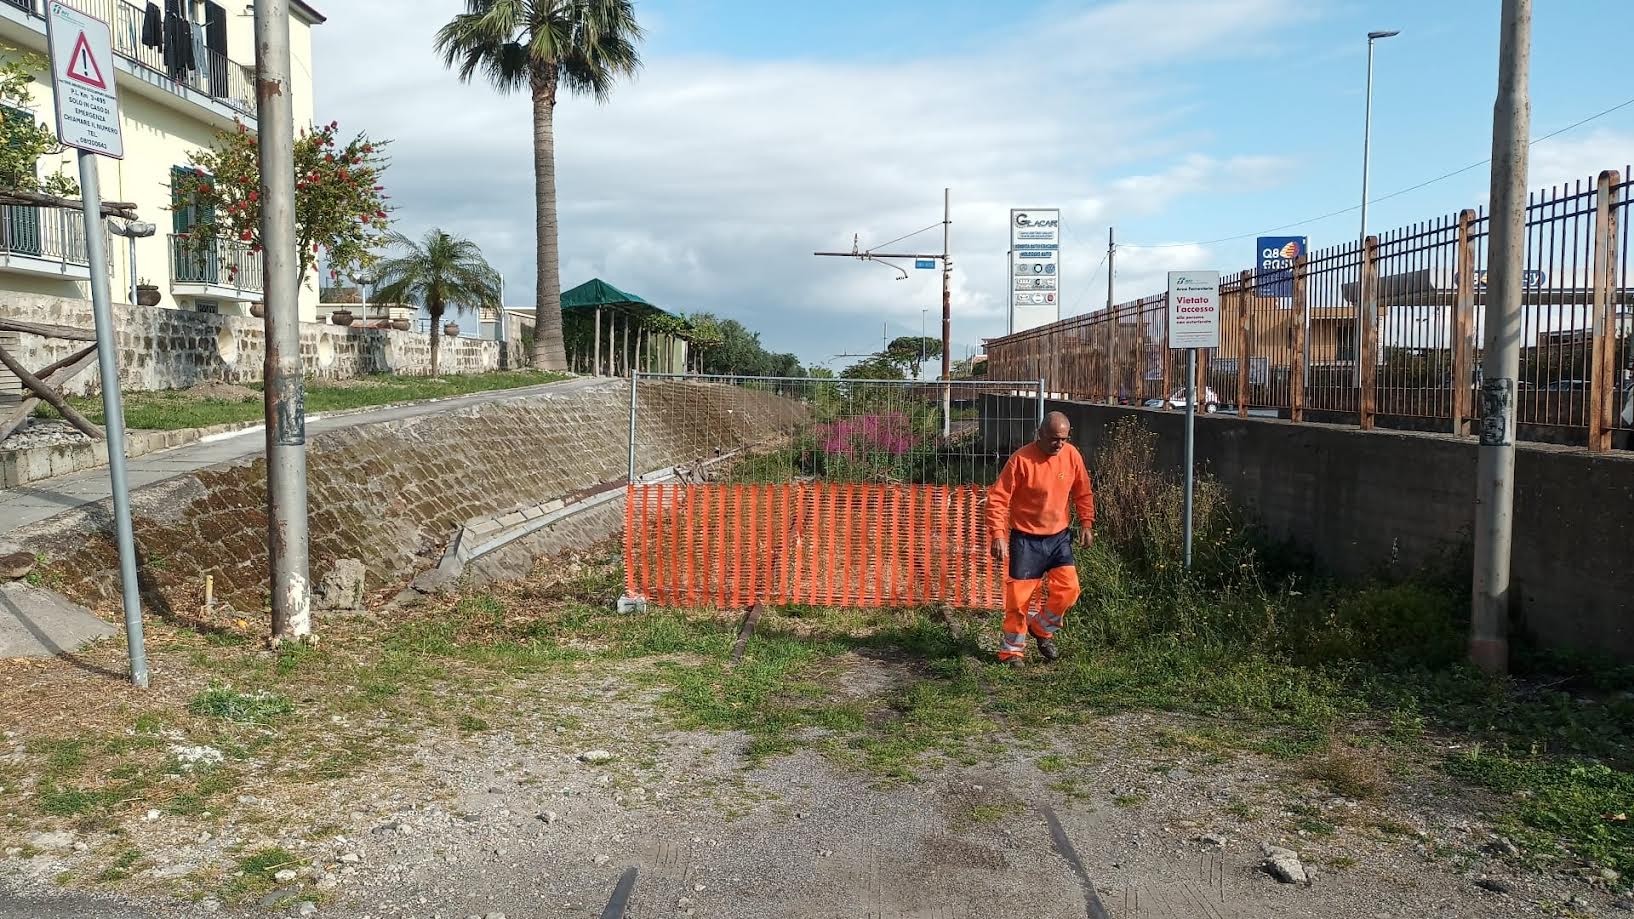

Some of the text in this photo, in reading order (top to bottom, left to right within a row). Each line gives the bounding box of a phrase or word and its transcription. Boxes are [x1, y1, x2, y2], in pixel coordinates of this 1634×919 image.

[68, 96, 83, 106] SOLO
[89, 103, 104, 113] CASO
[75, 107, 106, 122] EMERGENZA
[63, 113, 91, 127] CHIAMARE
[96, 123, 118, 135] NUMERO
[1262, 247, 1280, 259] Q8
[1176, 296, 1209, 304] Vietato
[1176, 305, 1214, 313] l'accesso
